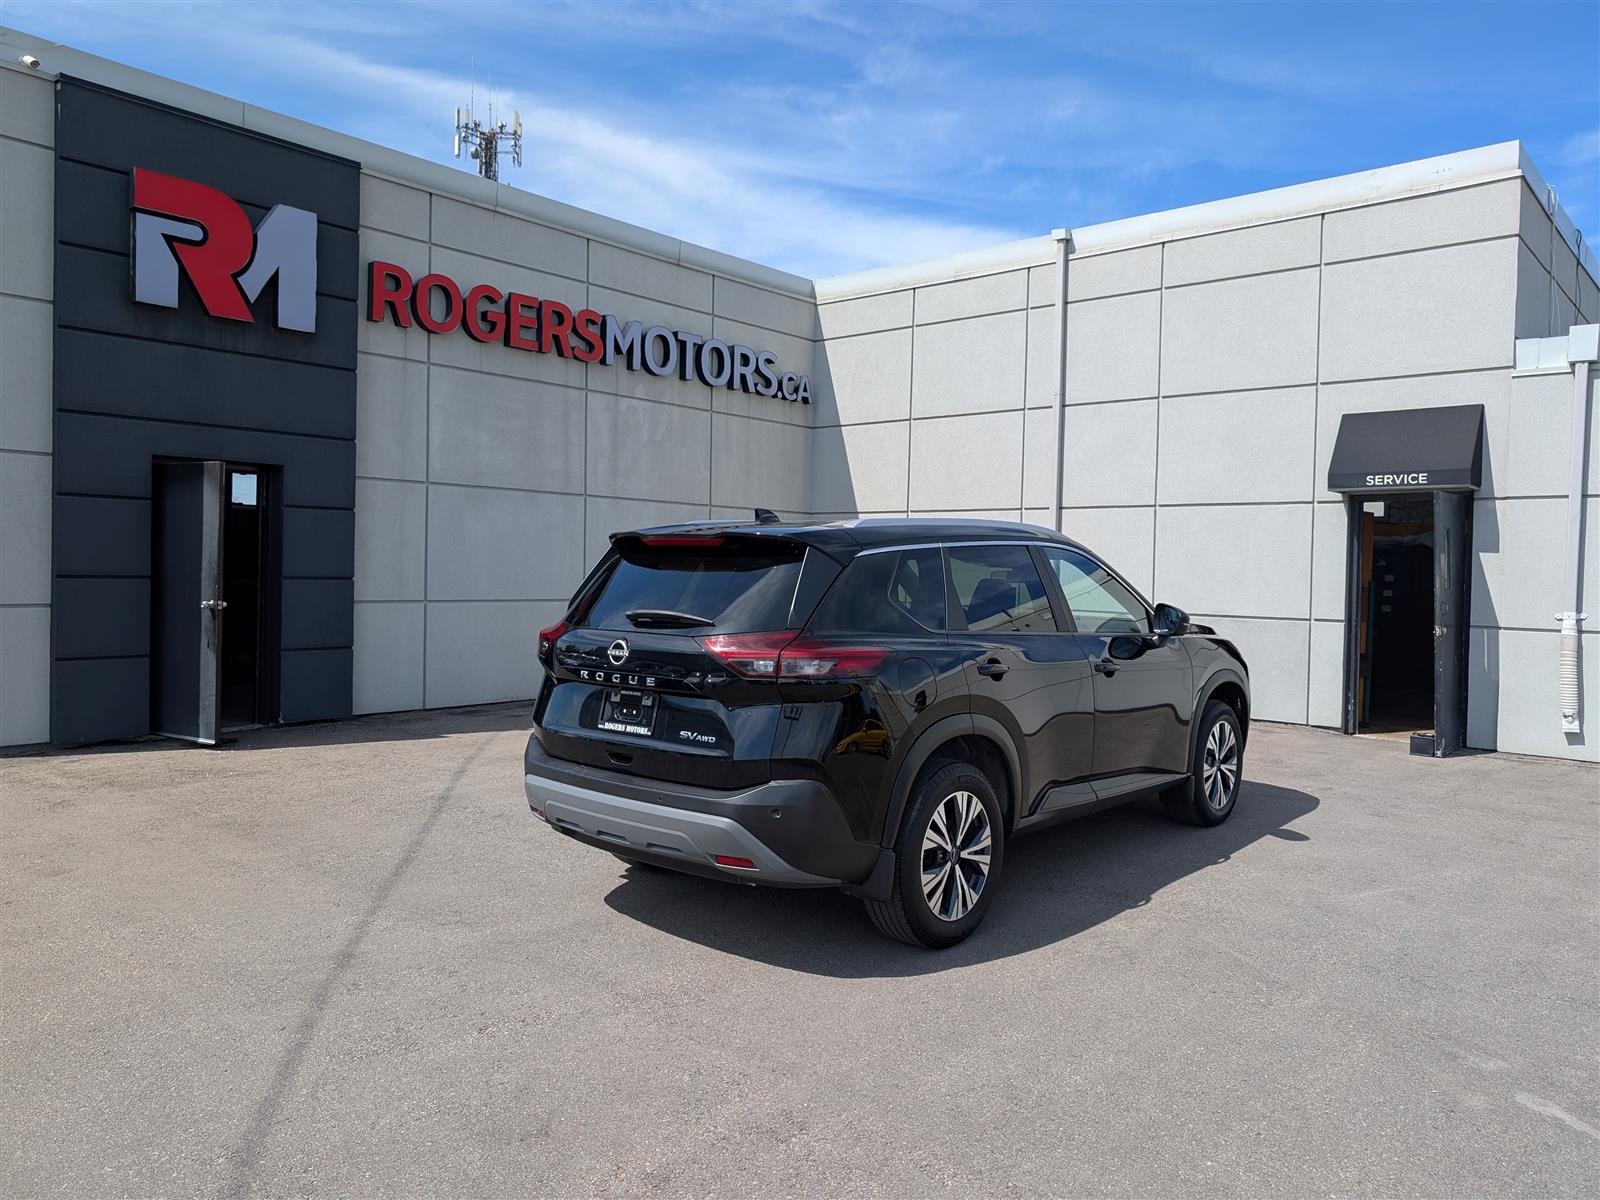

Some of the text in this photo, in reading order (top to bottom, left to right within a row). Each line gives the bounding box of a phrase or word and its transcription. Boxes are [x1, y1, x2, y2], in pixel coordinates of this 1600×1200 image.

[1366, 473, 1428, 485] SERVICE
[580, 670, 656, 686] ROGUE
[679, 730, 698, 740] SV
